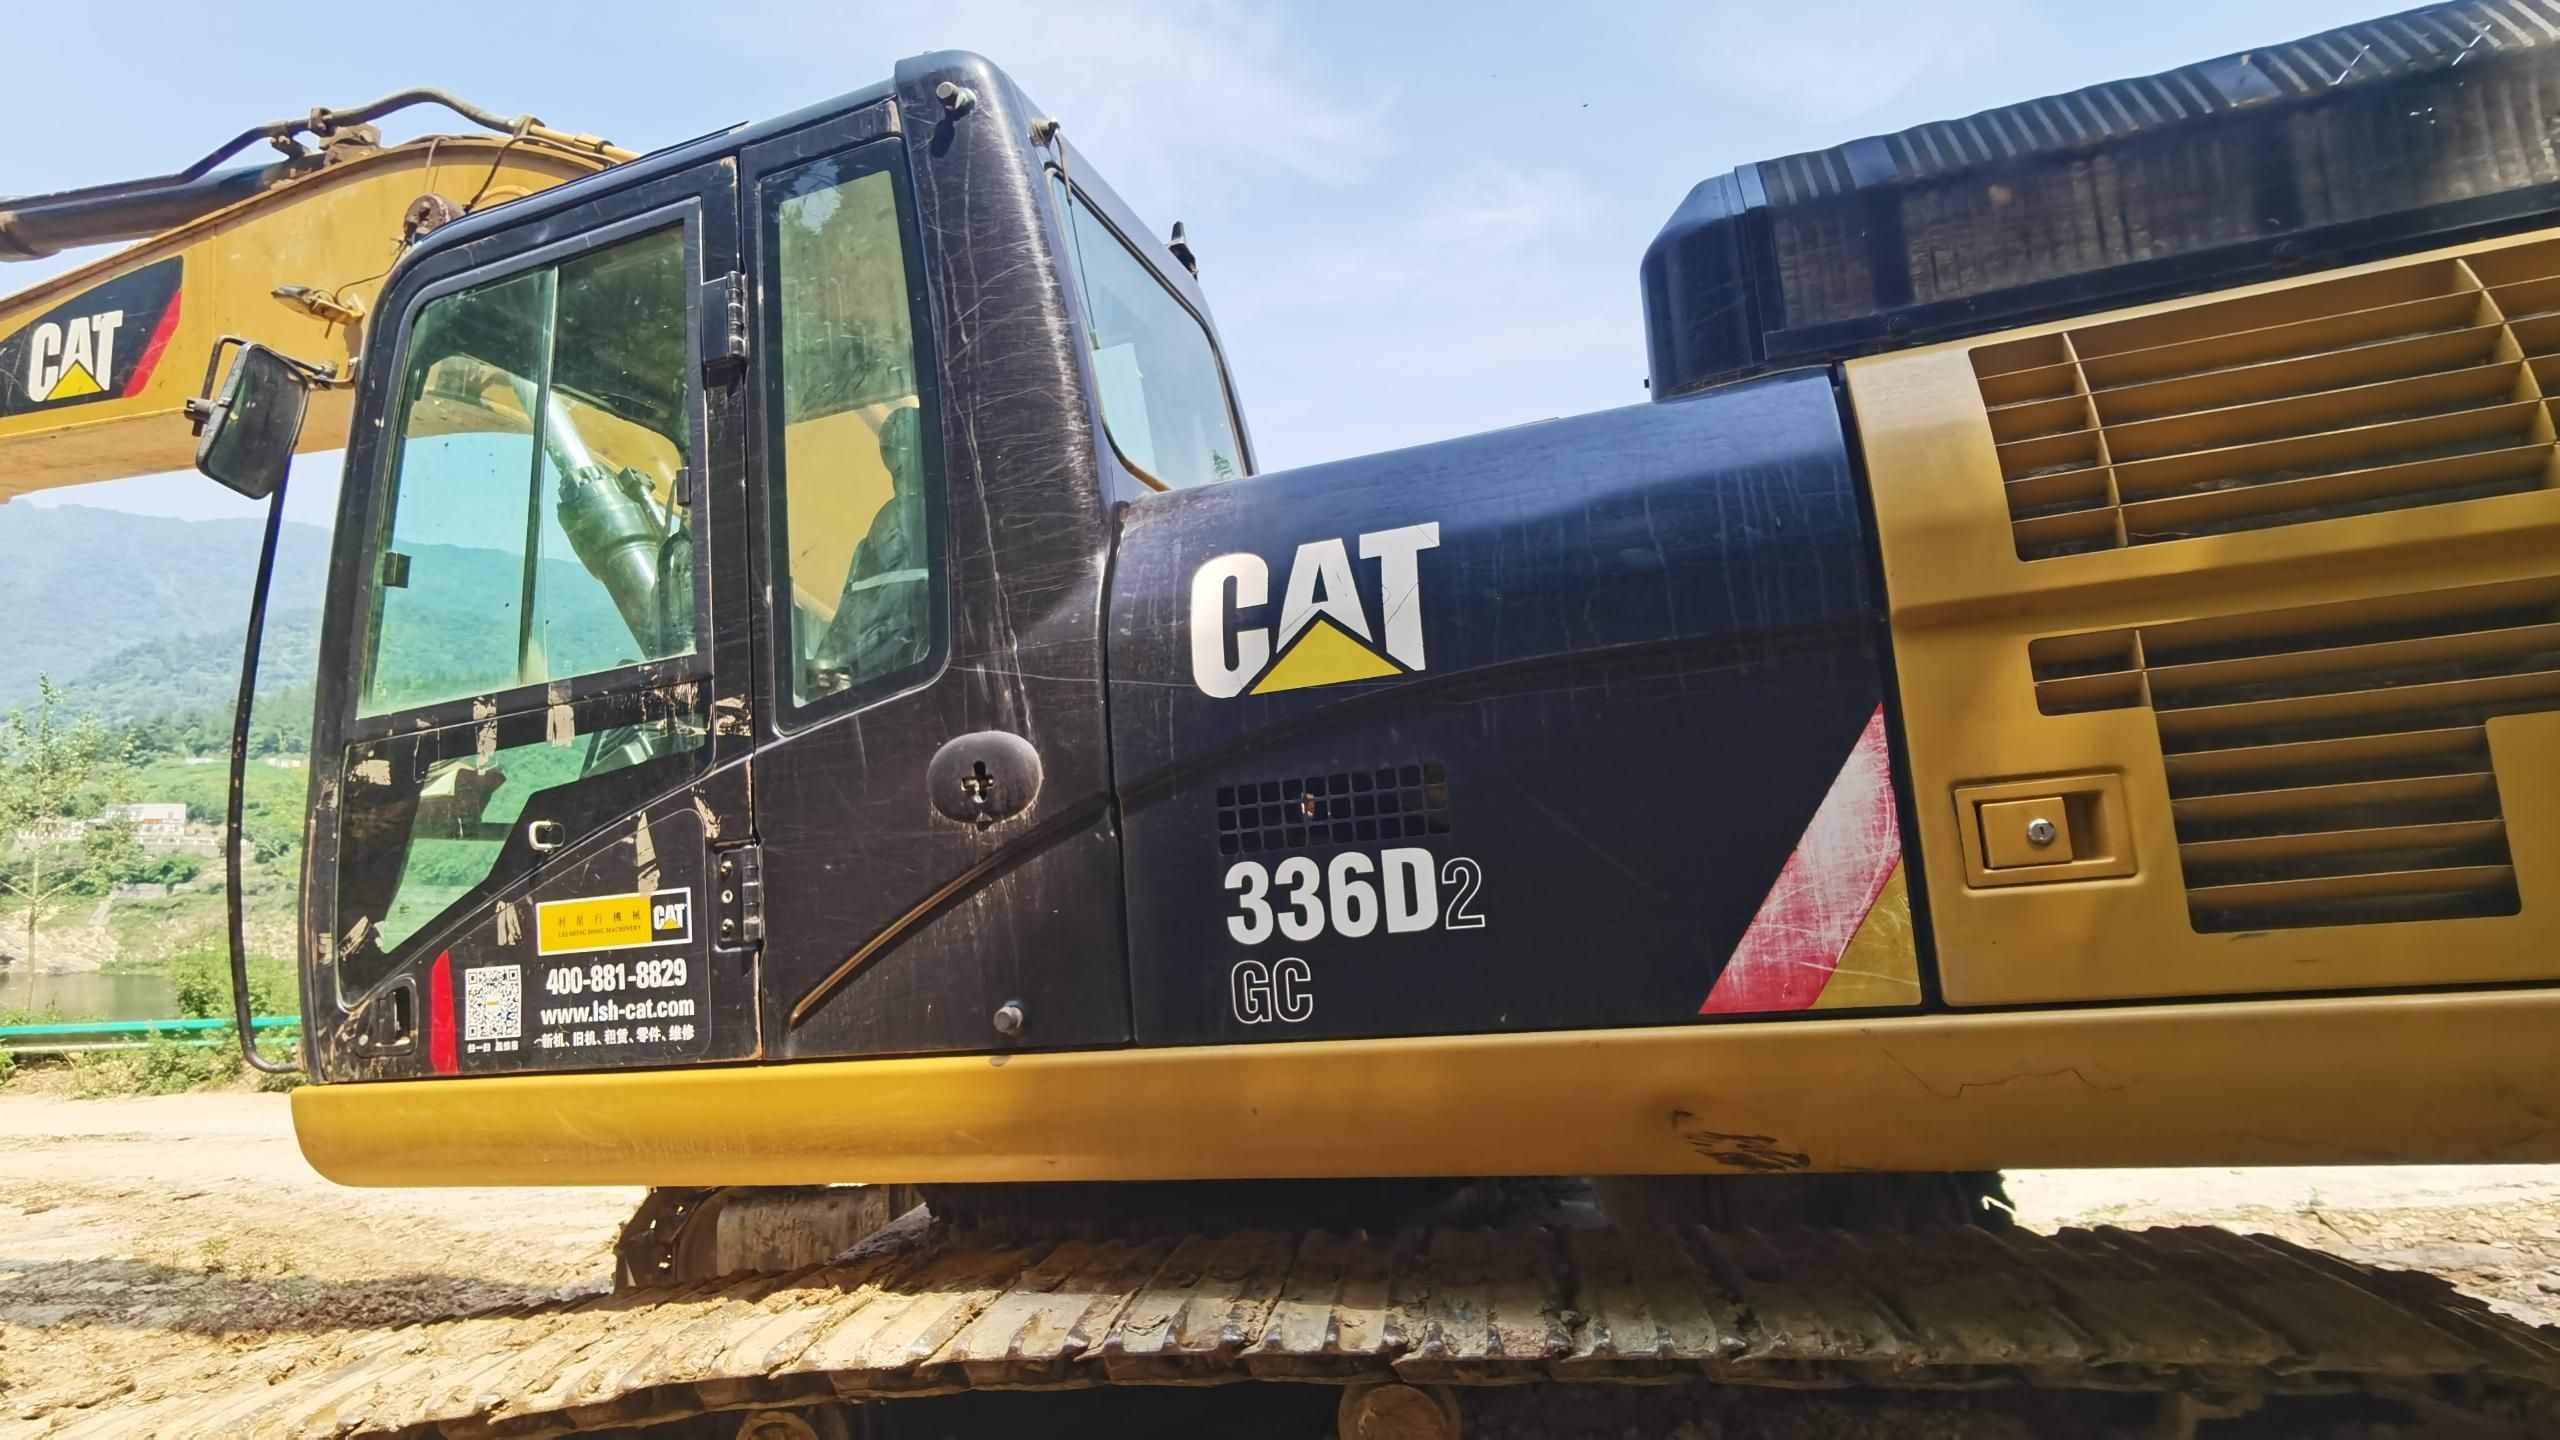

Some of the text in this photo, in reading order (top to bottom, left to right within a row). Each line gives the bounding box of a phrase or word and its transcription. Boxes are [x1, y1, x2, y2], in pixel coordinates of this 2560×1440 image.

[28, 310, 124, 402] CAT
[1191, 521, 1440, 699] CAT
[653, 903, 687, 931] CAT
[546, 957, 688, 996] 400-881-8829
[1231, 957, 1314, 1024] GC
[540, 998, 696, 1026] www.lsh-cat.com
